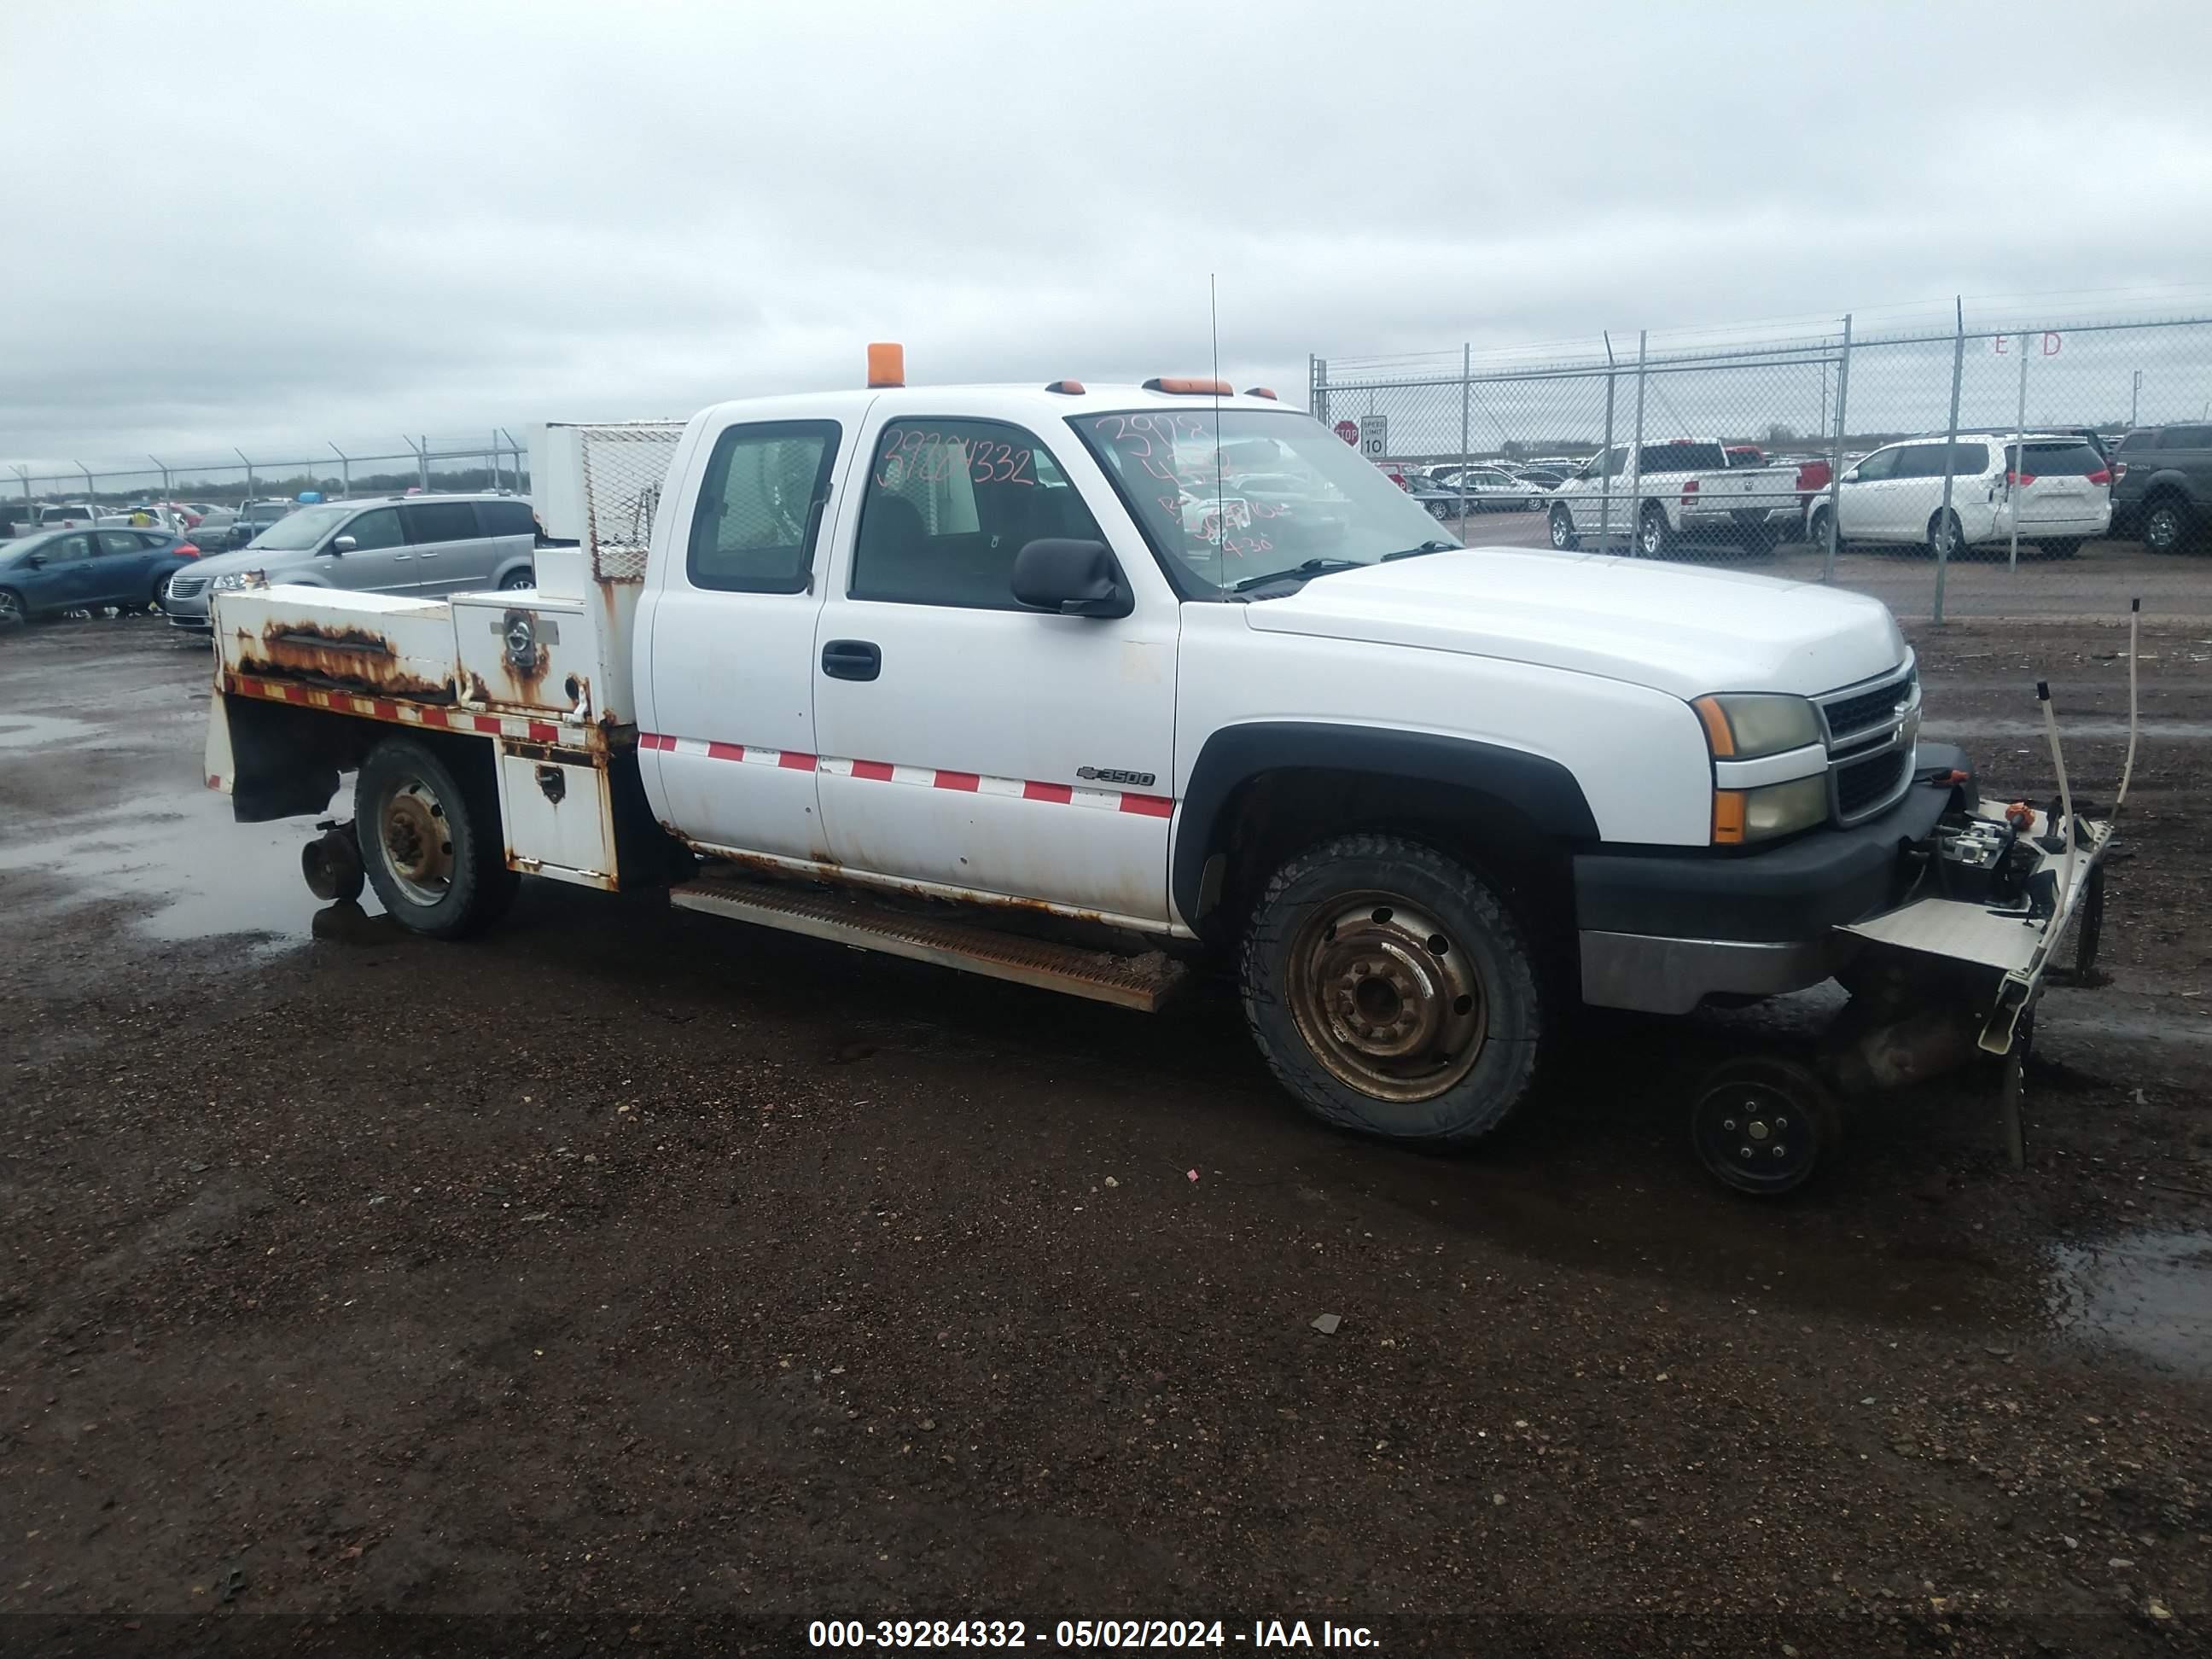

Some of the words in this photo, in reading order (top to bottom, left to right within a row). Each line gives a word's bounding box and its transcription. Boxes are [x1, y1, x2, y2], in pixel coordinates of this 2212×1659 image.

[2044, 331, 2061, 355] D
[1366, 440, 1382, 453] 10
[876, 428, 1034, 487] 39284332
[1101, 768, 1156, 786] 3500
